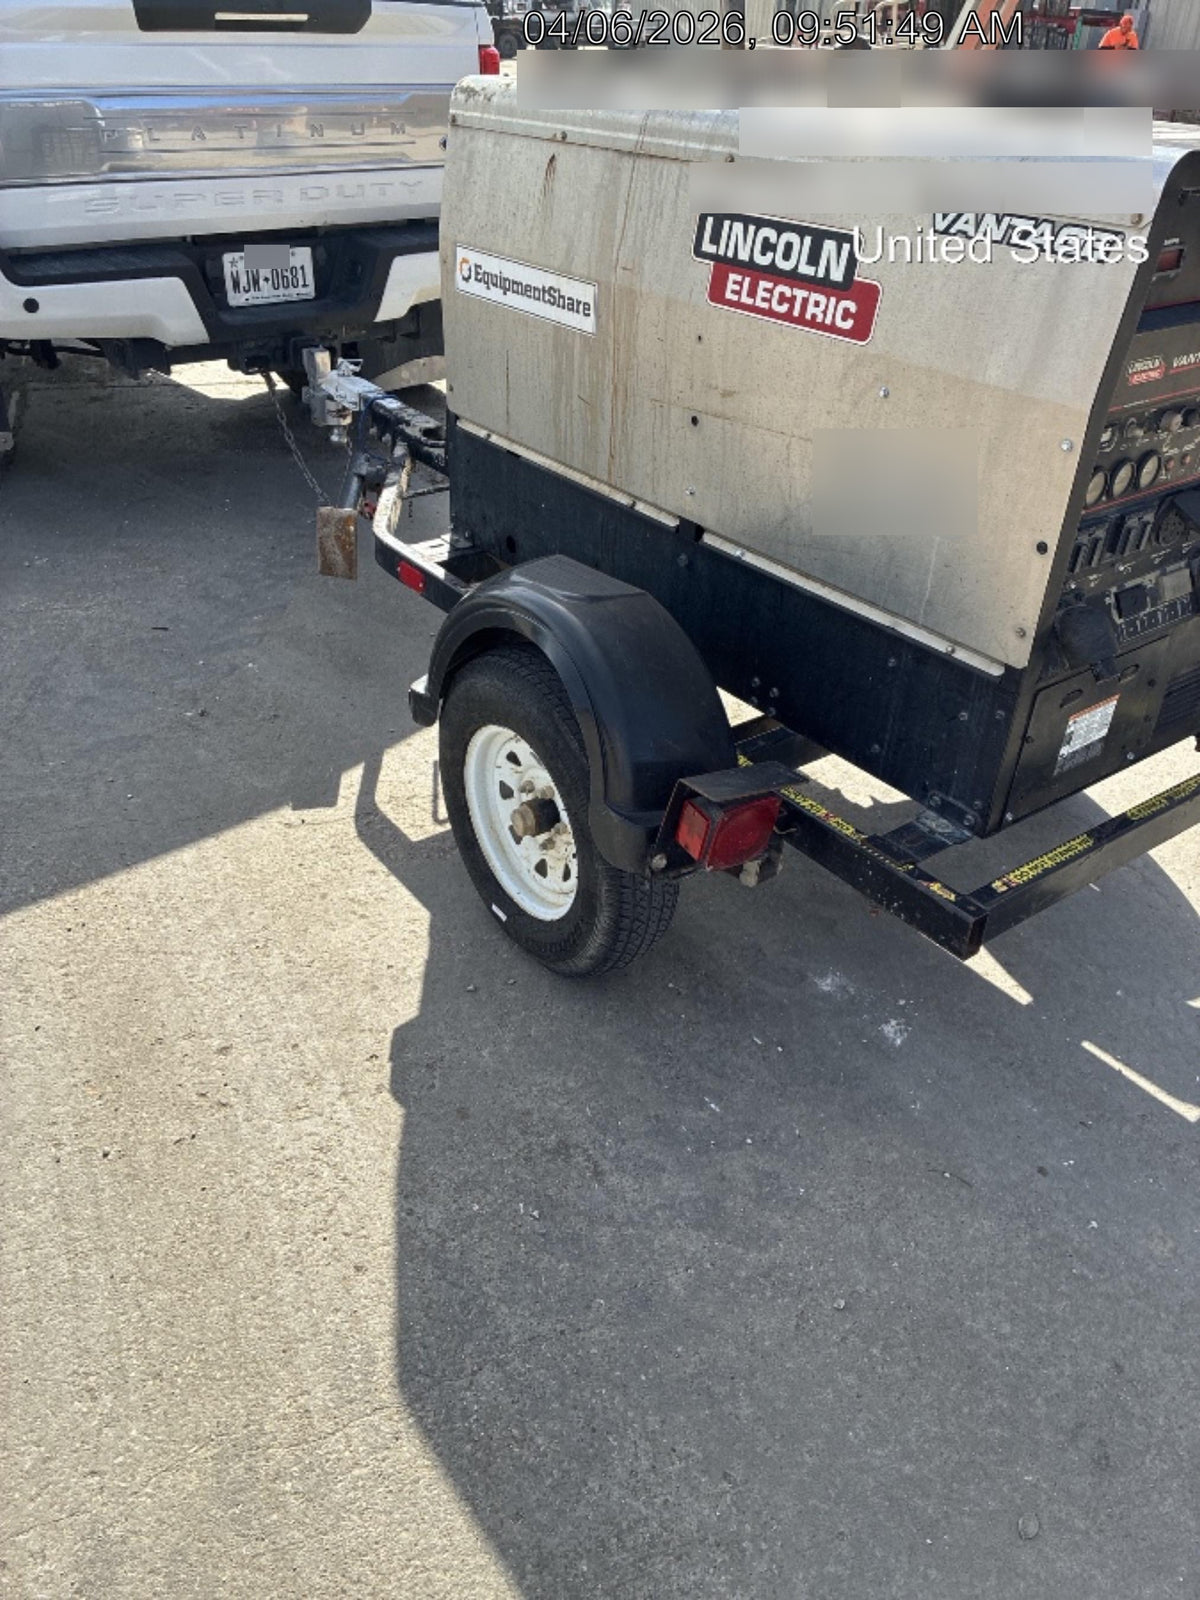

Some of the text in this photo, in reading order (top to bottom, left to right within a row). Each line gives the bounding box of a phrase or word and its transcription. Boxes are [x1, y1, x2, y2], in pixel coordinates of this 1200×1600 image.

[103, 122, 406, 142] PLATINUM
[84, 181, 423, 214] SUPER DUTY
[701, 216, 851, 282] LINCOLN
[474, 262, 592, 318] EquipmentShare
[725, 273, 857, 330] ELECTRIC
